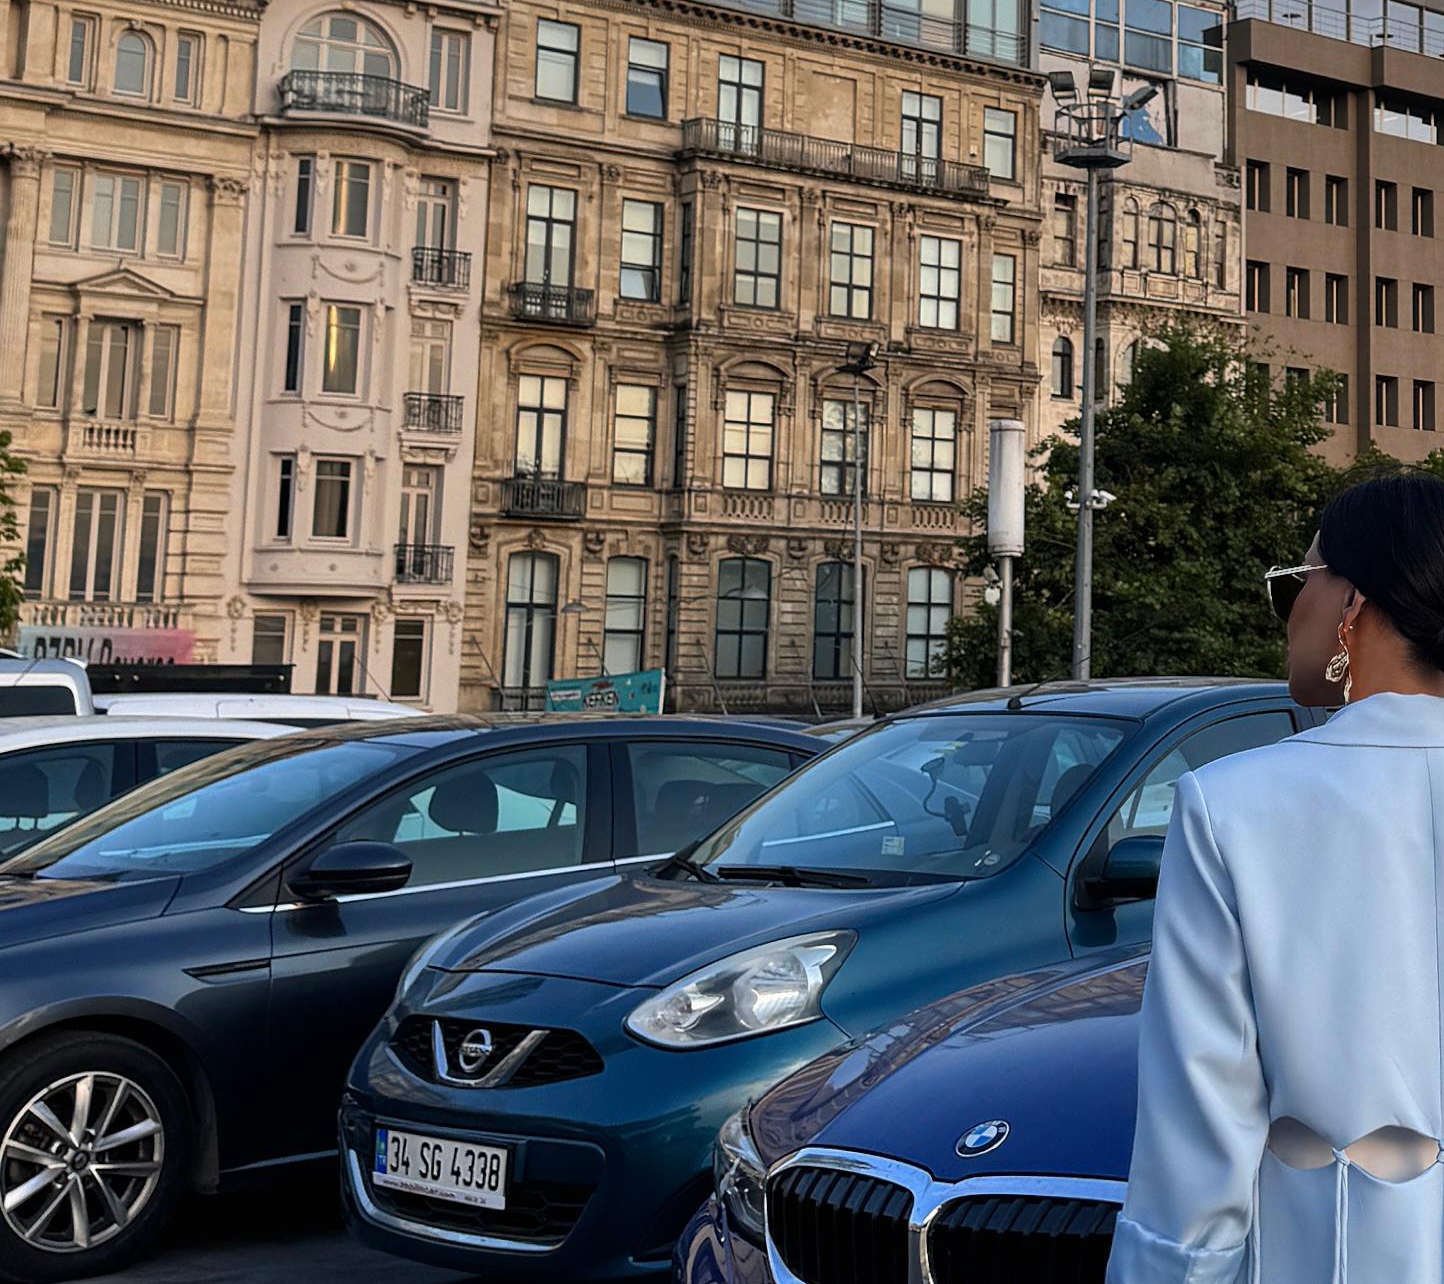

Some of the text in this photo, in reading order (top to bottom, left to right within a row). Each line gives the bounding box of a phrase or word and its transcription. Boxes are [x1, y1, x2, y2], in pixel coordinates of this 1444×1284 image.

[390, 1136, 410, 1176] 34
[419, 1142, 442, 1181] SG
[451, 1147, 501, 1192] 4338
